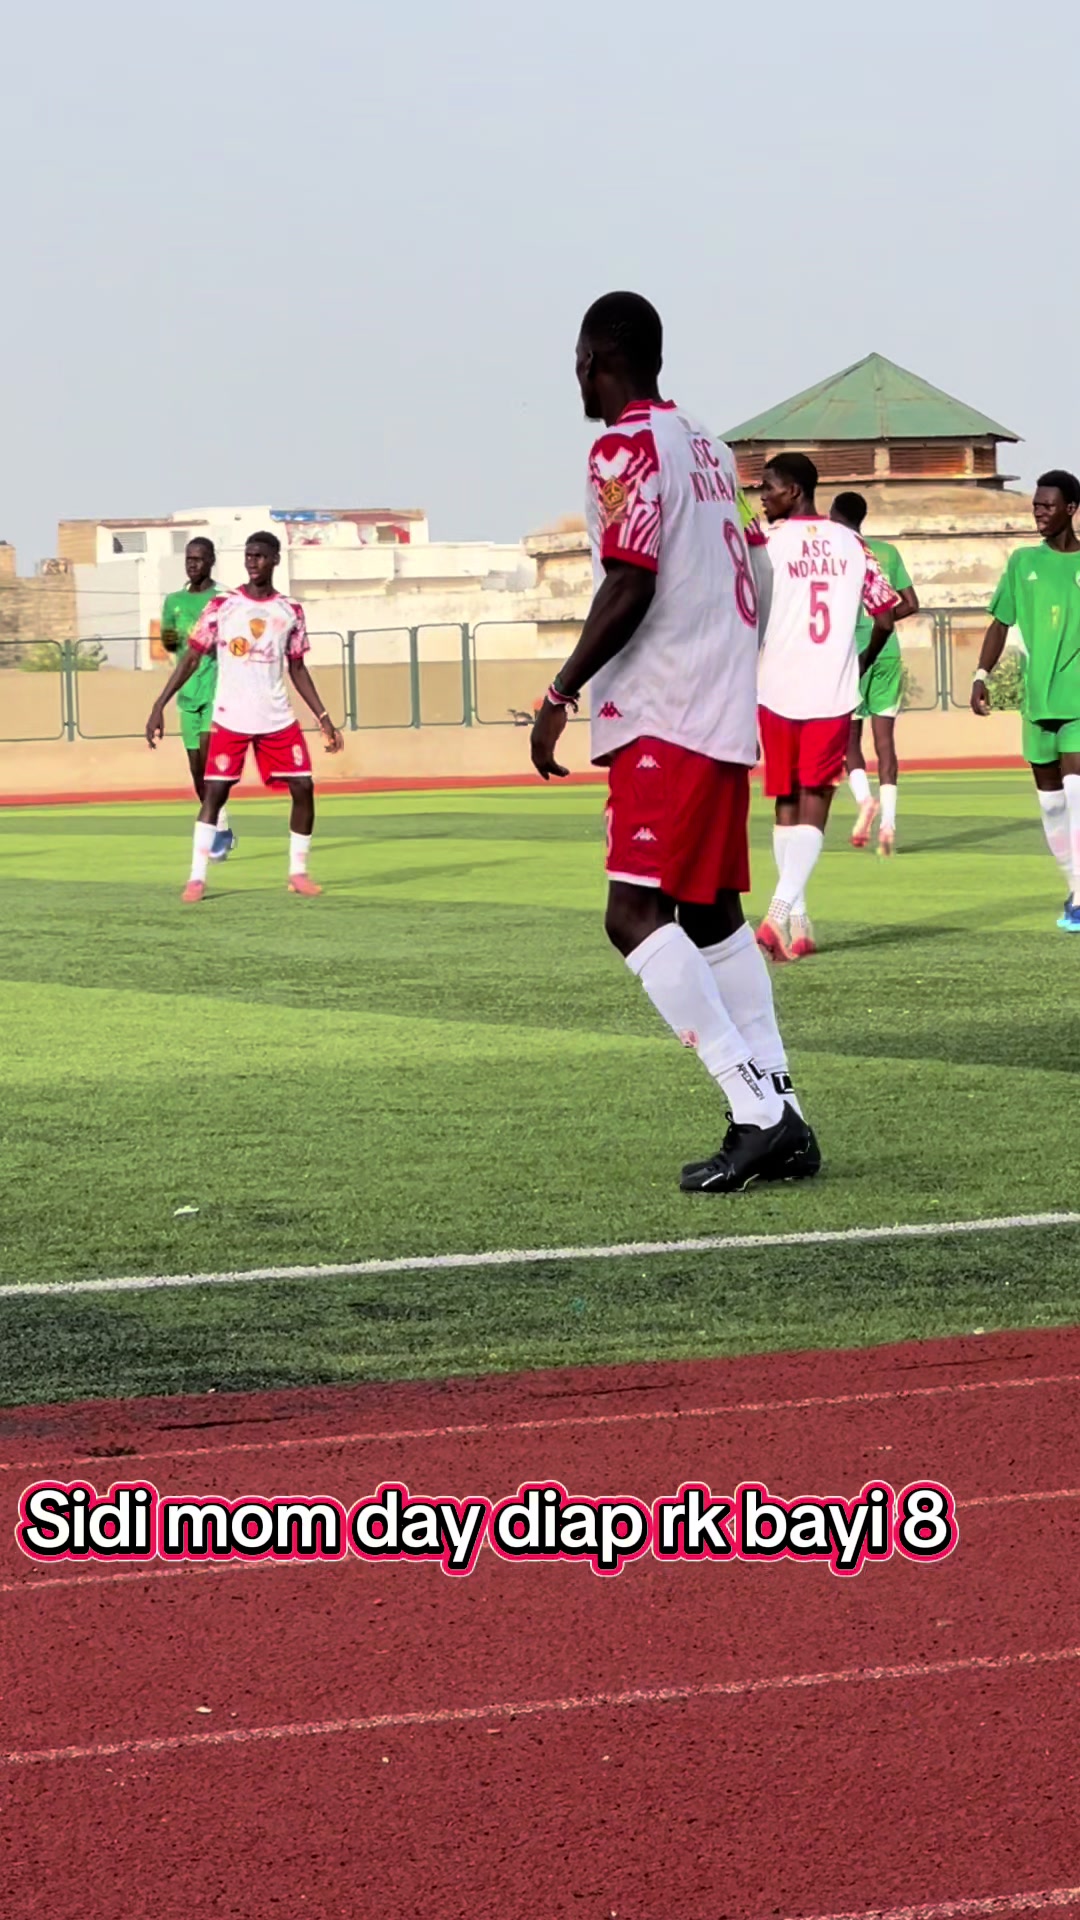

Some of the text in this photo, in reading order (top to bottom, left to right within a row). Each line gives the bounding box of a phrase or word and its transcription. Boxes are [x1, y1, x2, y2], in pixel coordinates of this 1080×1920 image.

[691, 438, 720, 469] ASC
[802, 540, 831, 557] ASC
[723, 518, 757, 628] 8
[787, 559, 848, 578] NDAALY
[809, 581, 831, 644] 5
